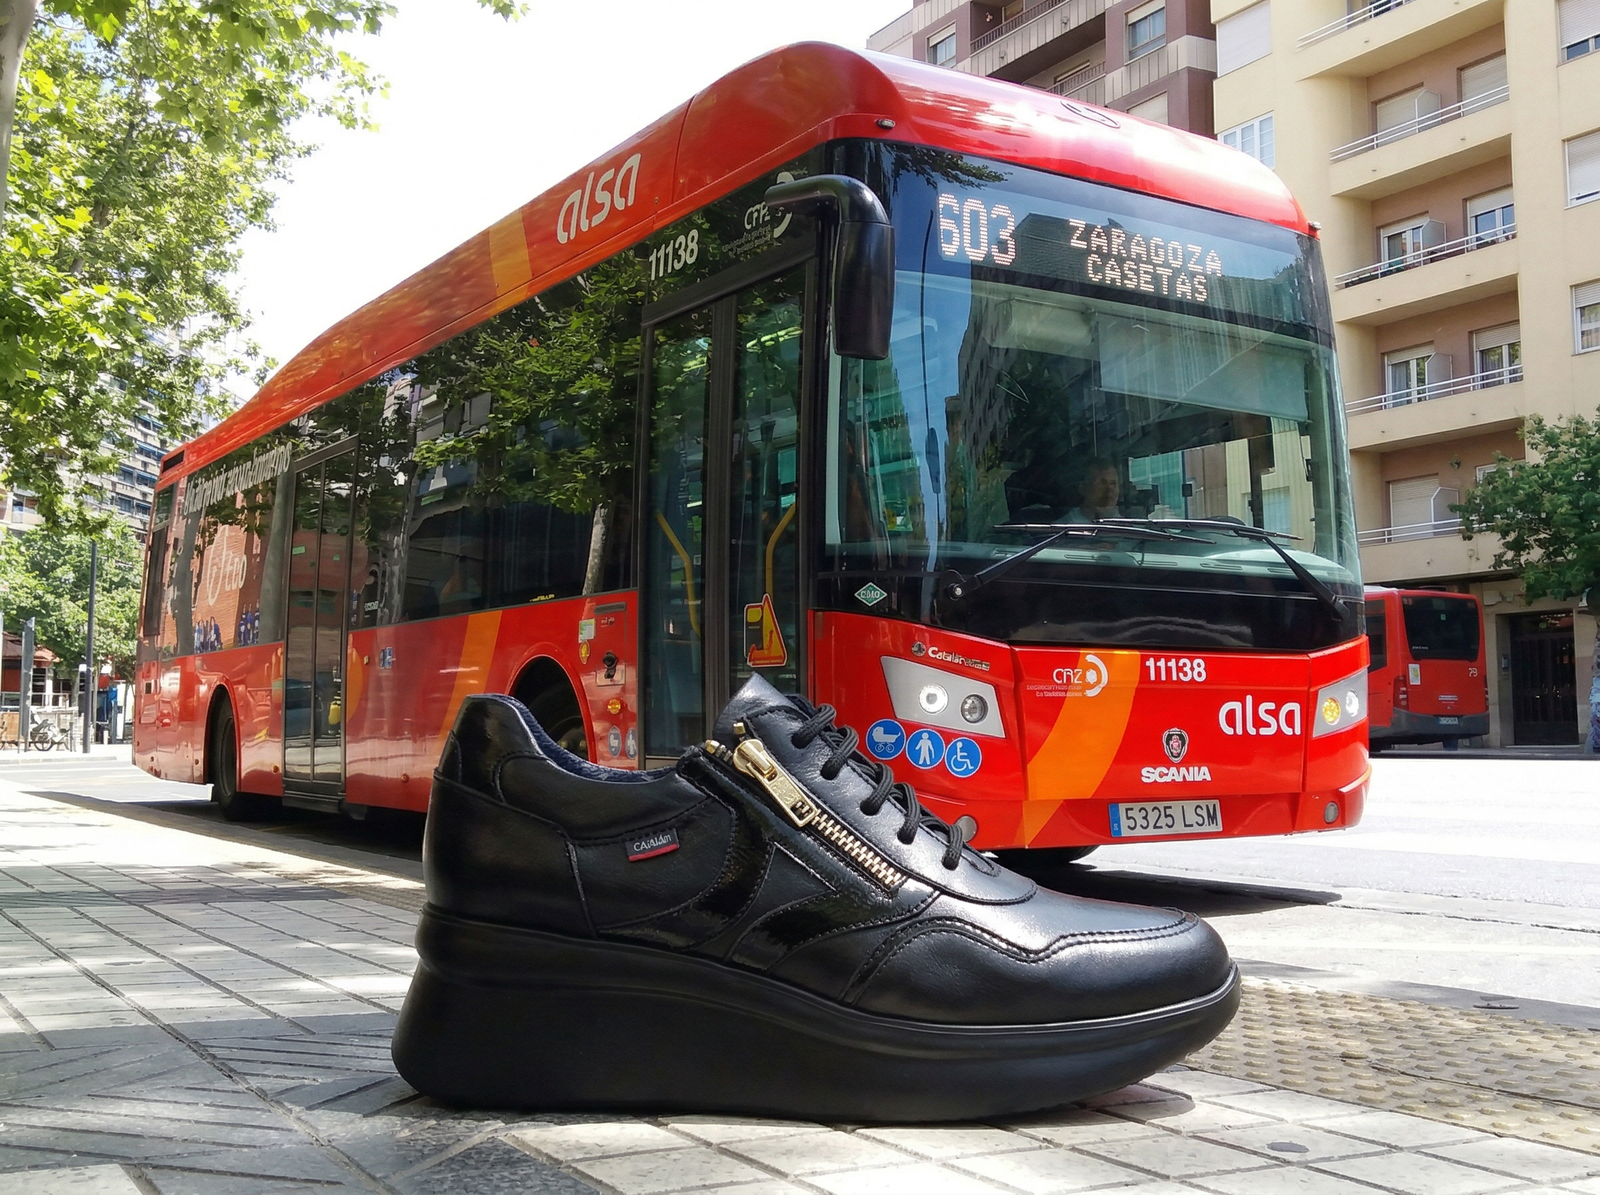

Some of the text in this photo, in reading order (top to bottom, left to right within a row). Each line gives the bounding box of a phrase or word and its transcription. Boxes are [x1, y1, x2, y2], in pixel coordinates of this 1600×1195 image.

[556, 153, 642, 244] alsa
[938, 193, 1016, 265] 603
[1069, 218, 1222, 276] ZARAGOZA
[649, 229, 699, 281] 11138
[1087, 253, 1209, 301] CASETAS
[1145, 657, 1206, 682] 11138
[1218, 694, 1301, 736] alsa
[1141, 766, 1212, 783] SCANIA
[1125, 804, 1219, 831] 5325 LSM
